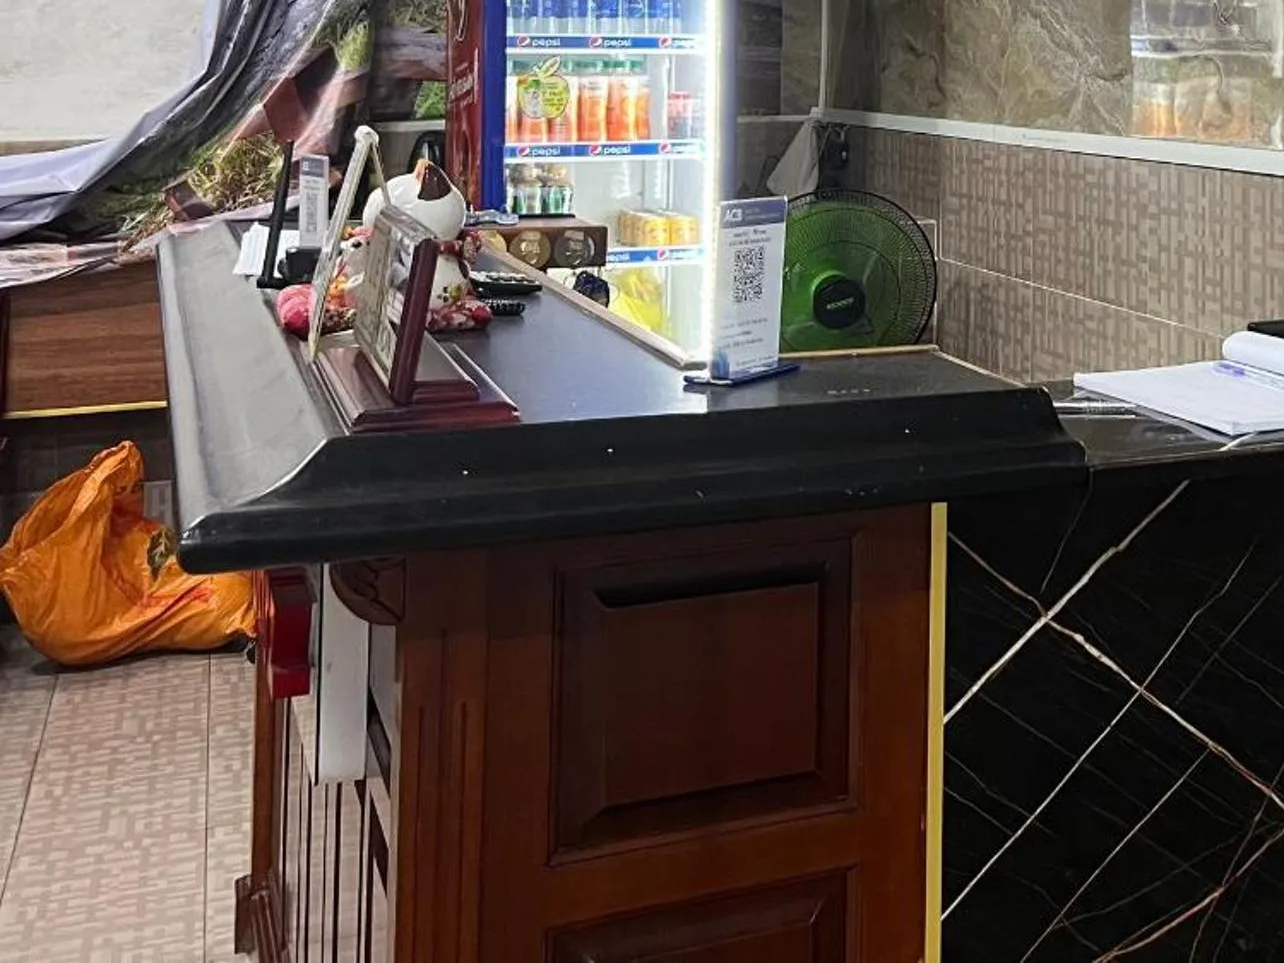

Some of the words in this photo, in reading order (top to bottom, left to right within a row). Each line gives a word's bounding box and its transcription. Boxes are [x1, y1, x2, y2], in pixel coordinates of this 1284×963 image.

[532, 38, 561, 48] pepsi
[604, 38, 631, 48] pepsi
[532, 146, 561, 157] pepsi
[603, 145, 631, 155] pepsi
